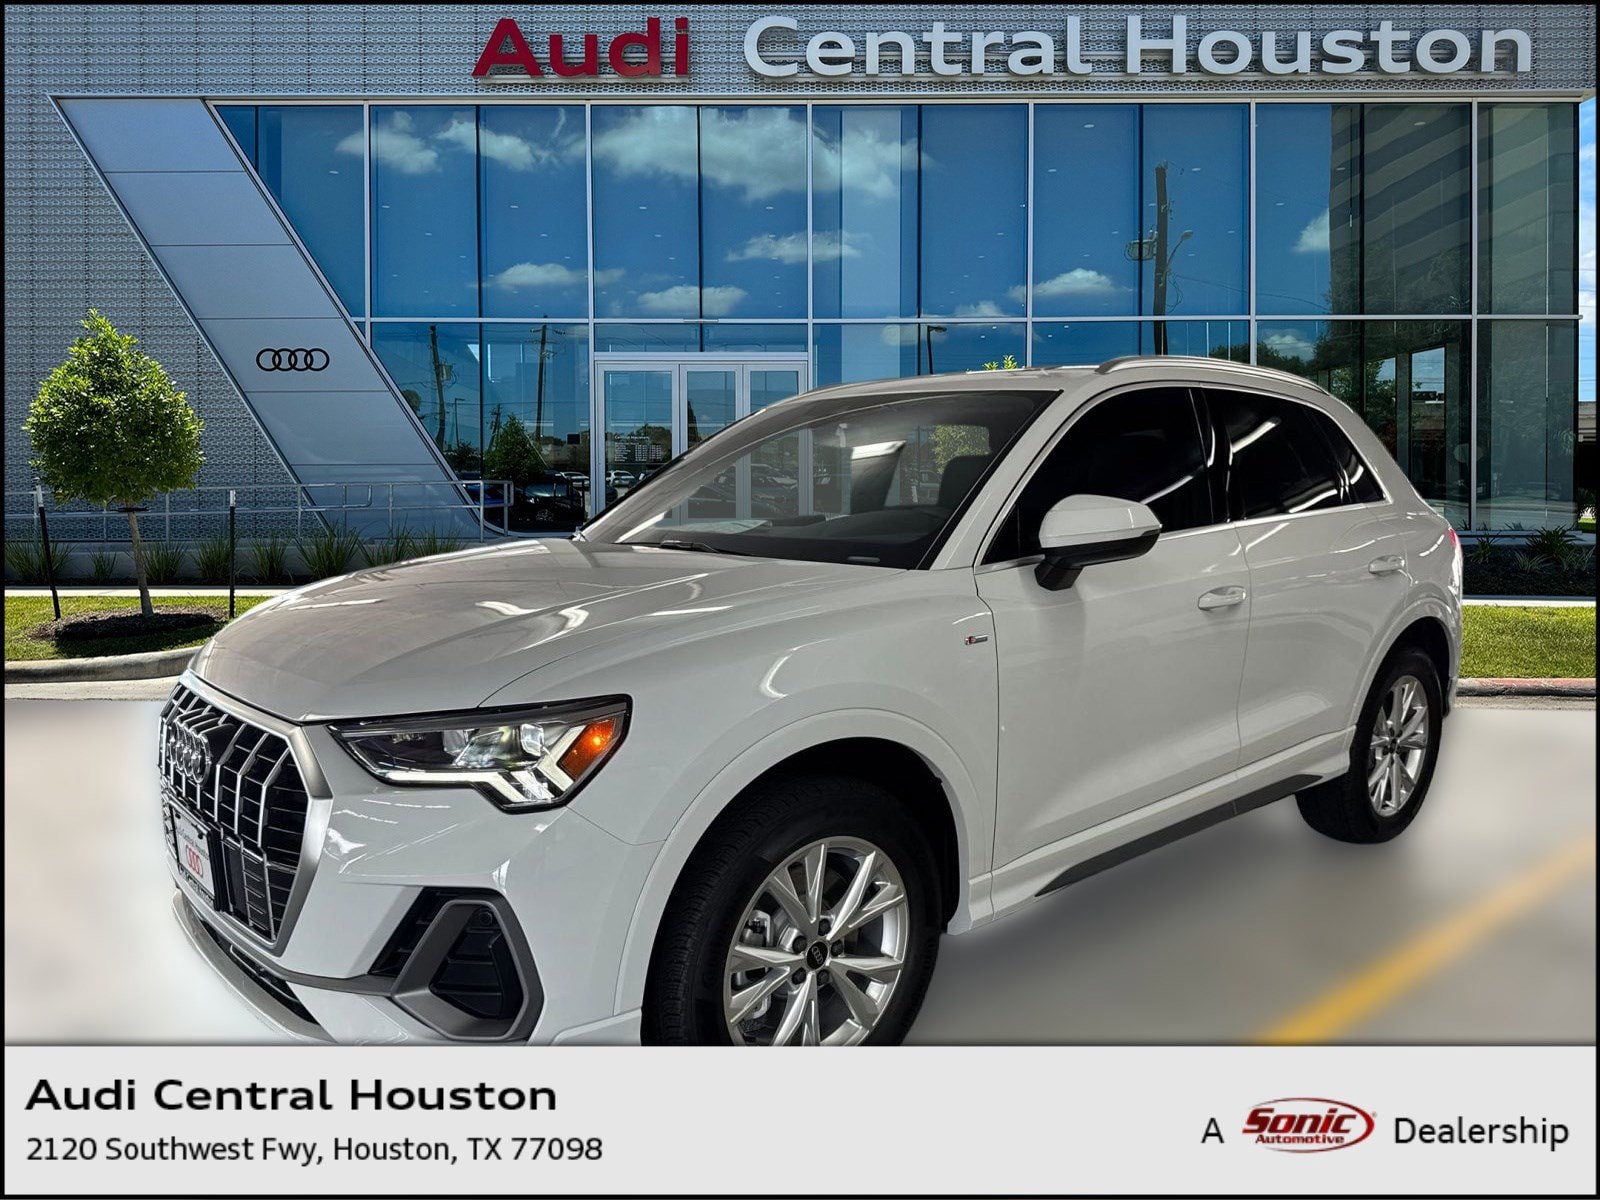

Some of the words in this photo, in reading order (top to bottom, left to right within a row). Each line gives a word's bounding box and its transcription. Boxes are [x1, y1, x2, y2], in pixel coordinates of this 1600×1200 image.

[471, 16, 689, 78] Audi
[743, 15, 1093, 77] Central
[1126, 14, 1532, 75] Houston
